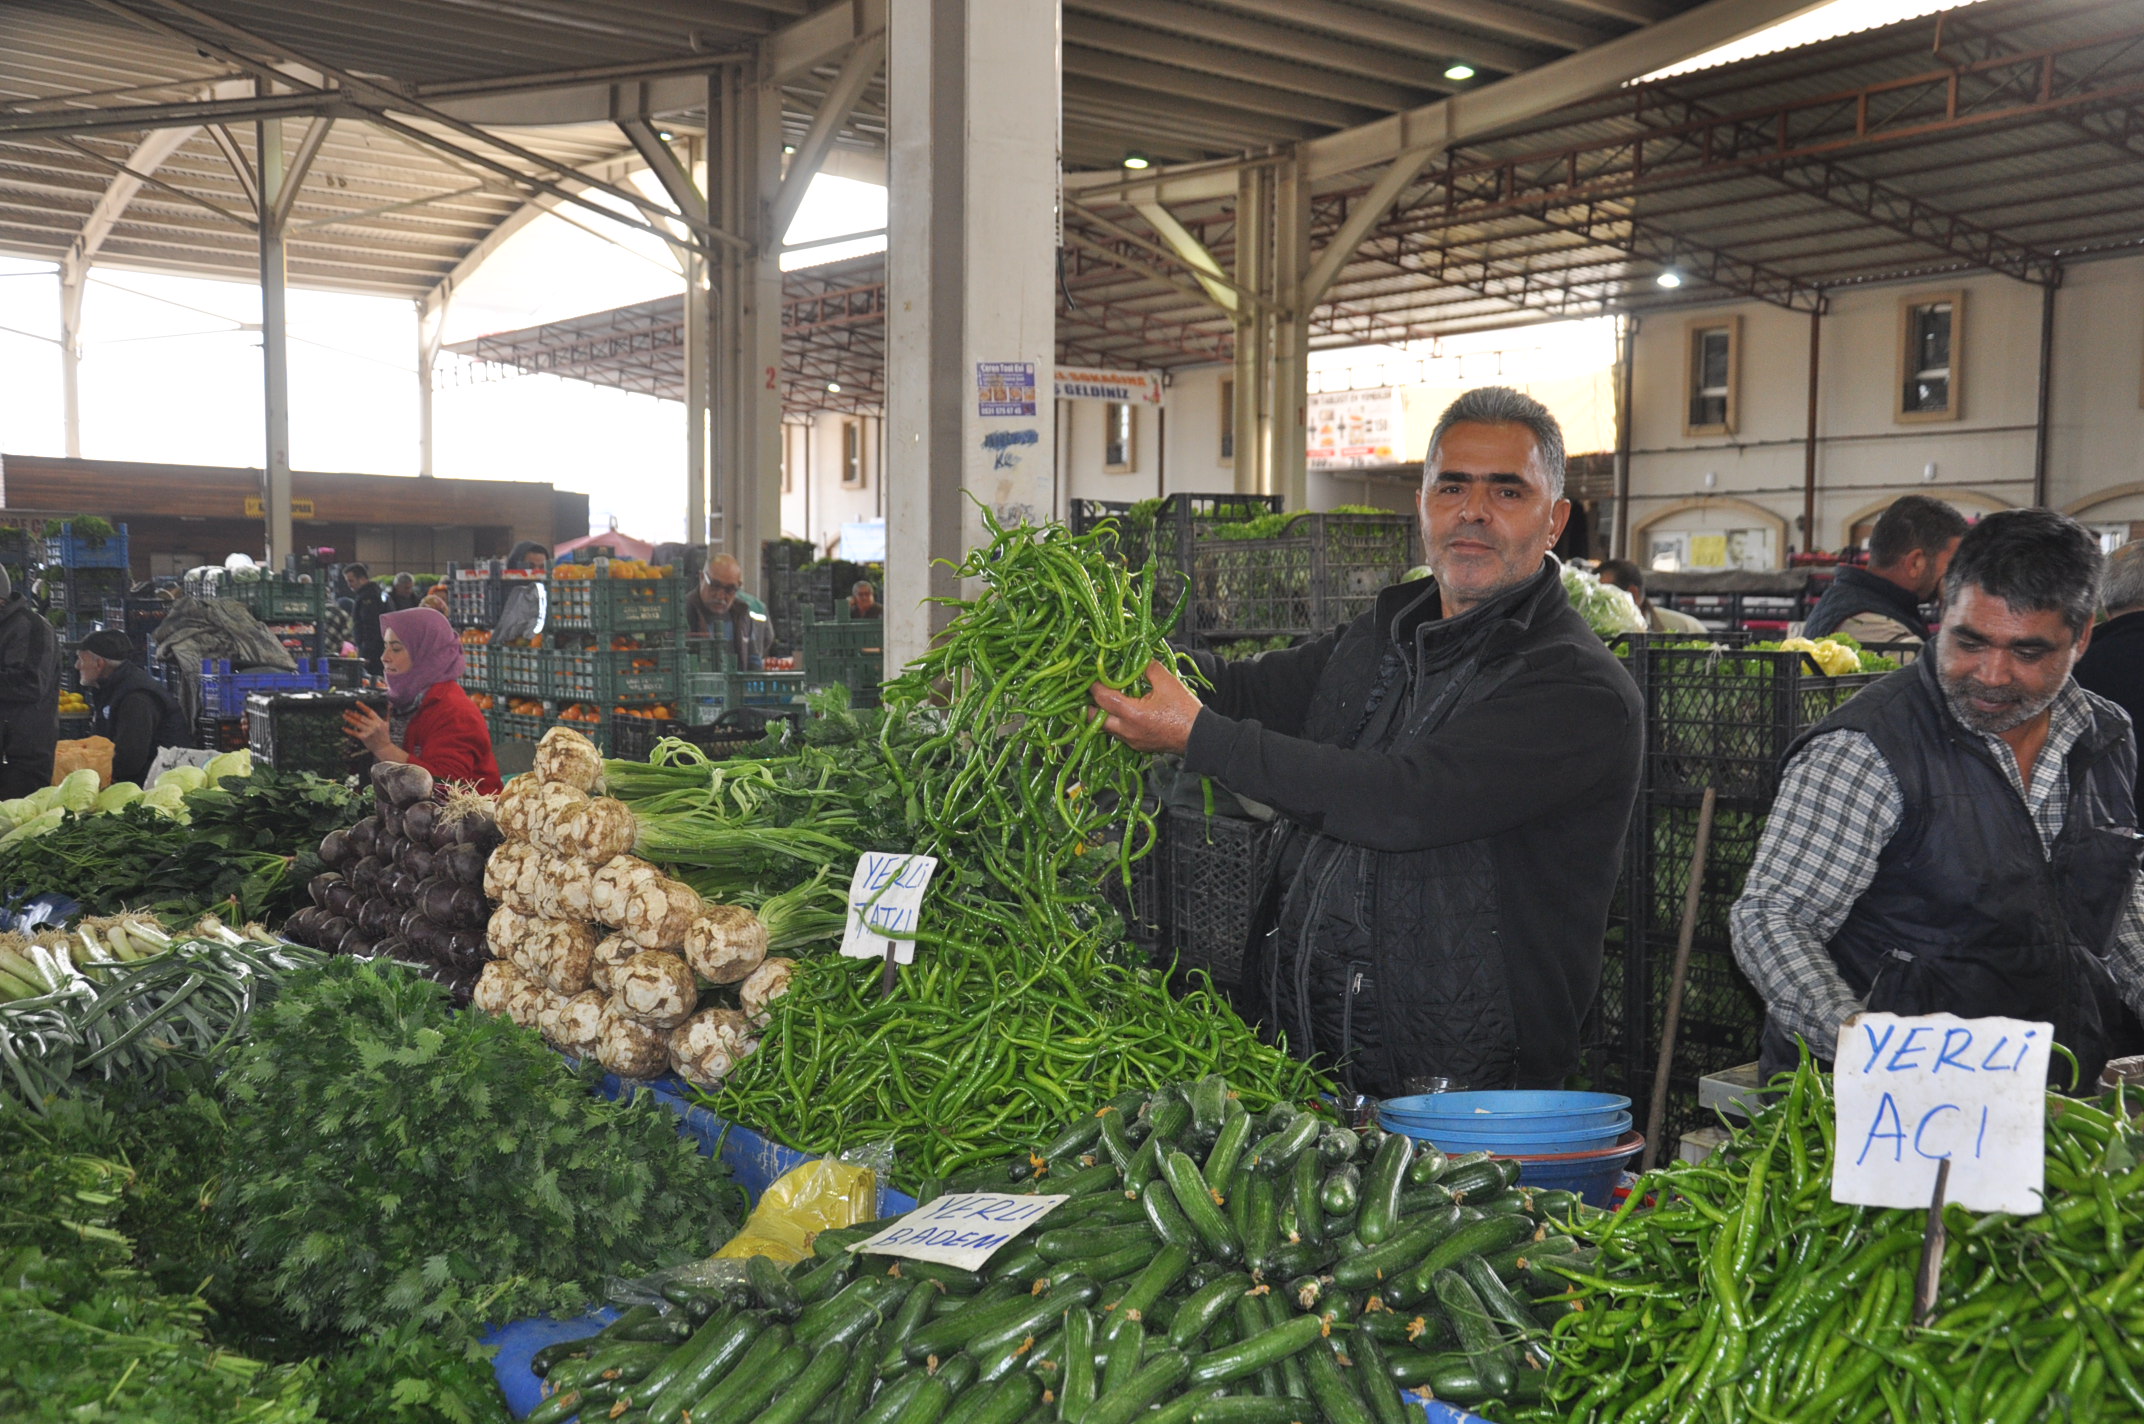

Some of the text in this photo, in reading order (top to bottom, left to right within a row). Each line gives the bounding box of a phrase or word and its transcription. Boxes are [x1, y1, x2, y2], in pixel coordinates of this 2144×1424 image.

[765, 366, 776, 390] 2
[1064, 384, 1130, 399] GELDİNİZ
[276, 449, 286, 466] 2
[1856, 1091, 1988, 1166] ACI
[871, 1226, 1010, 1250] BADEM
